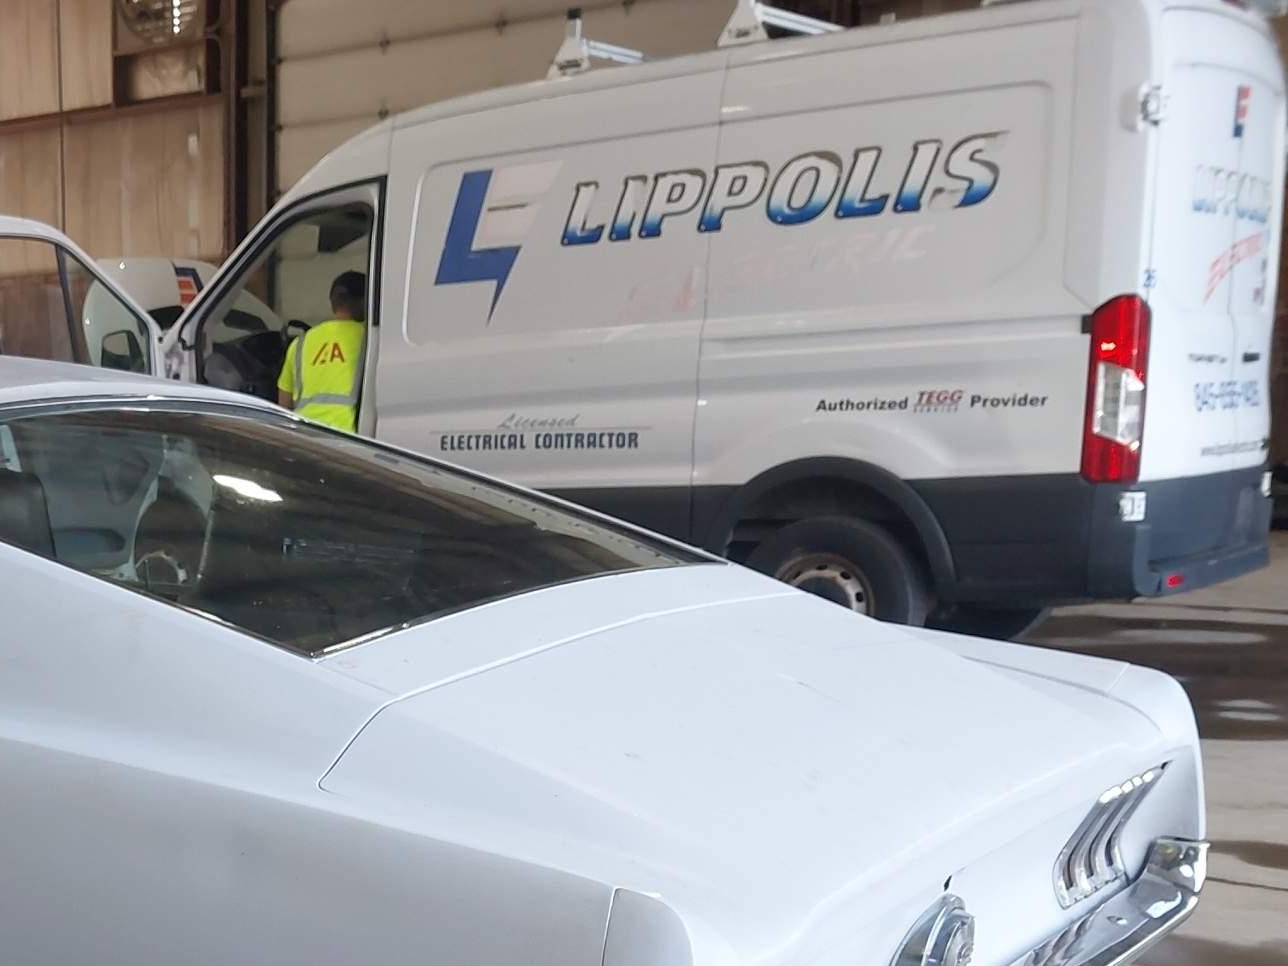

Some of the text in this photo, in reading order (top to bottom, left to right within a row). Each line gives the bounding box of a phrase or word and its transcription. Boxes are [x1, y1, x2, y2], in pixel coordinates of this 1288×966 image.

[560, 130, 1011, 246] LIPPOLIS
[815, 396, 909, 412] Authorized
[969, 393, 1048, 409] Provider
[496, 412, 581, 430] Licensed
[440, 432, 639, 451] ELECTRICAL CONTRACTOR
